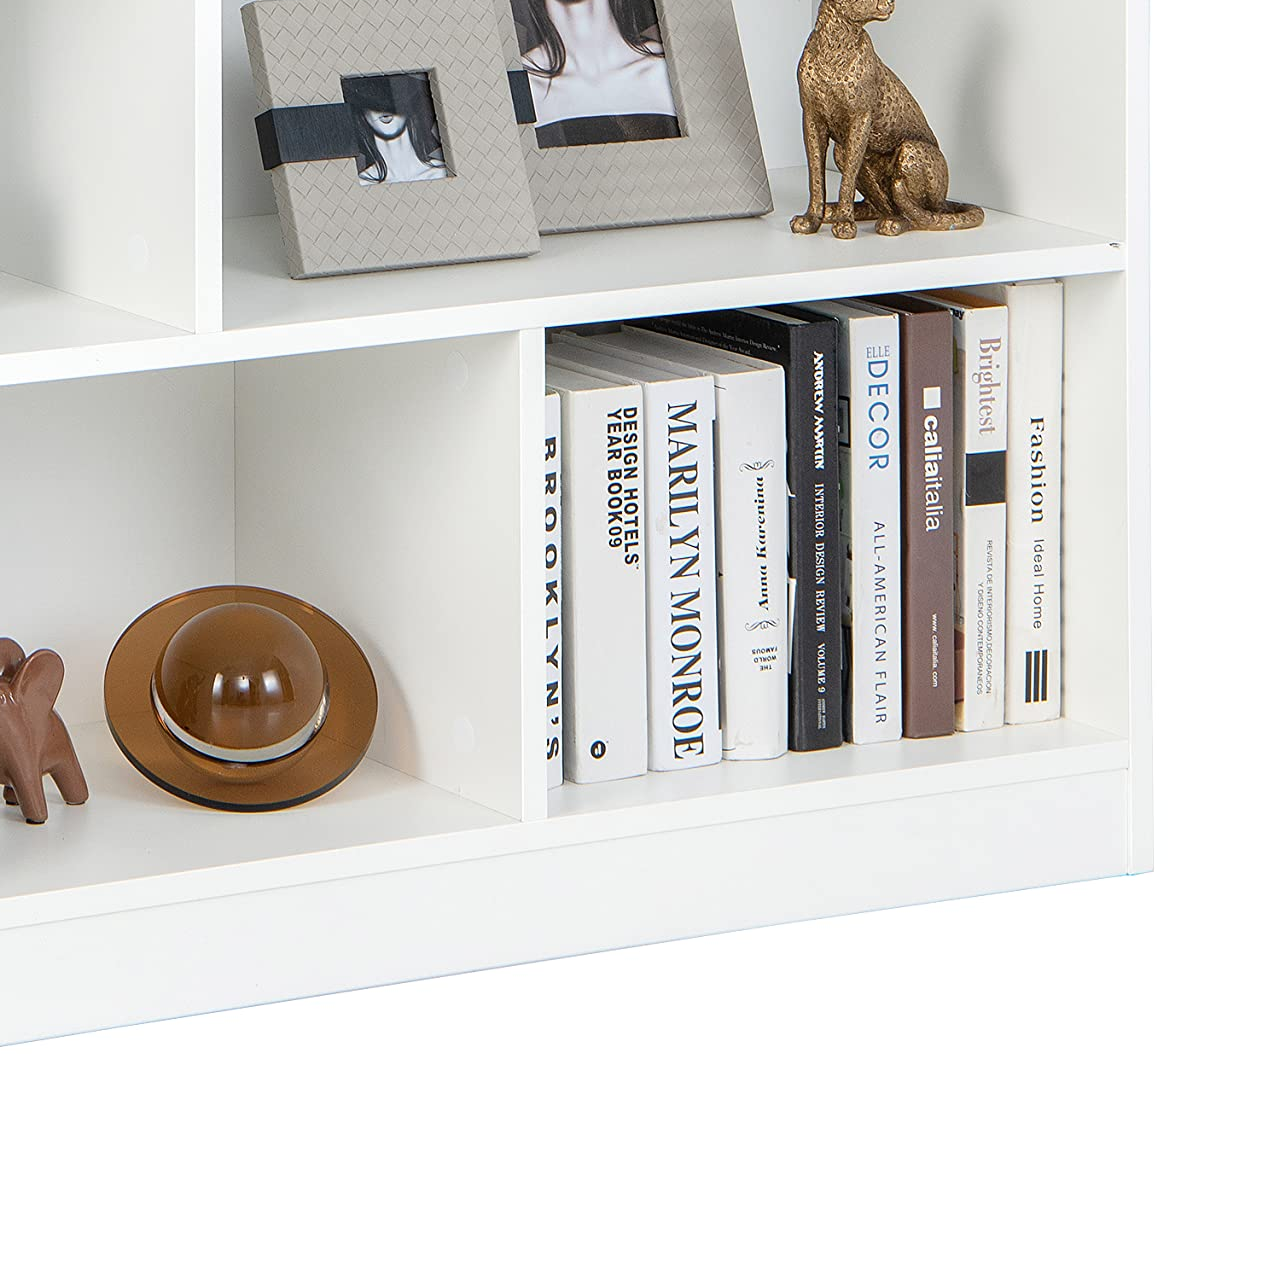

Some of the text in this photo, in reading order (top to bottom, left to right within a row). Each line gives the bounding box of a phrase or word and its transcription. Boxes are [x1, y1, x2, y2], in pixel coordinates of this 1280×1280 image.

[866, 346, 890, 358] ELLE
[867, 360, 890, 470] DECOR
[971, 336, 1002, 437] Brightest
[607, 408, 622, 460] YEAR
[623, 407, 638, 480] DESIGN
[923, 415, 945, 532] caliaitalia
[814, 483, 825, 538] INTERIOR
[1029, 416, 1047, 630] Fashion Ideal Home
[754, 476, 769, 611] Anna Karenina
[814, 542, 826, 586] DESIGN
[667, 400, 705, 760] MARILYN MONROE
[815, 590, 826, 633] REVIEW
[986, 574, 993, 585] DE
[873, 521, 888, 724] ALL-AMERICAN FLAIR
[816, 642, 826, 684] VOLUME
[818, 685, 826, 694] 9
